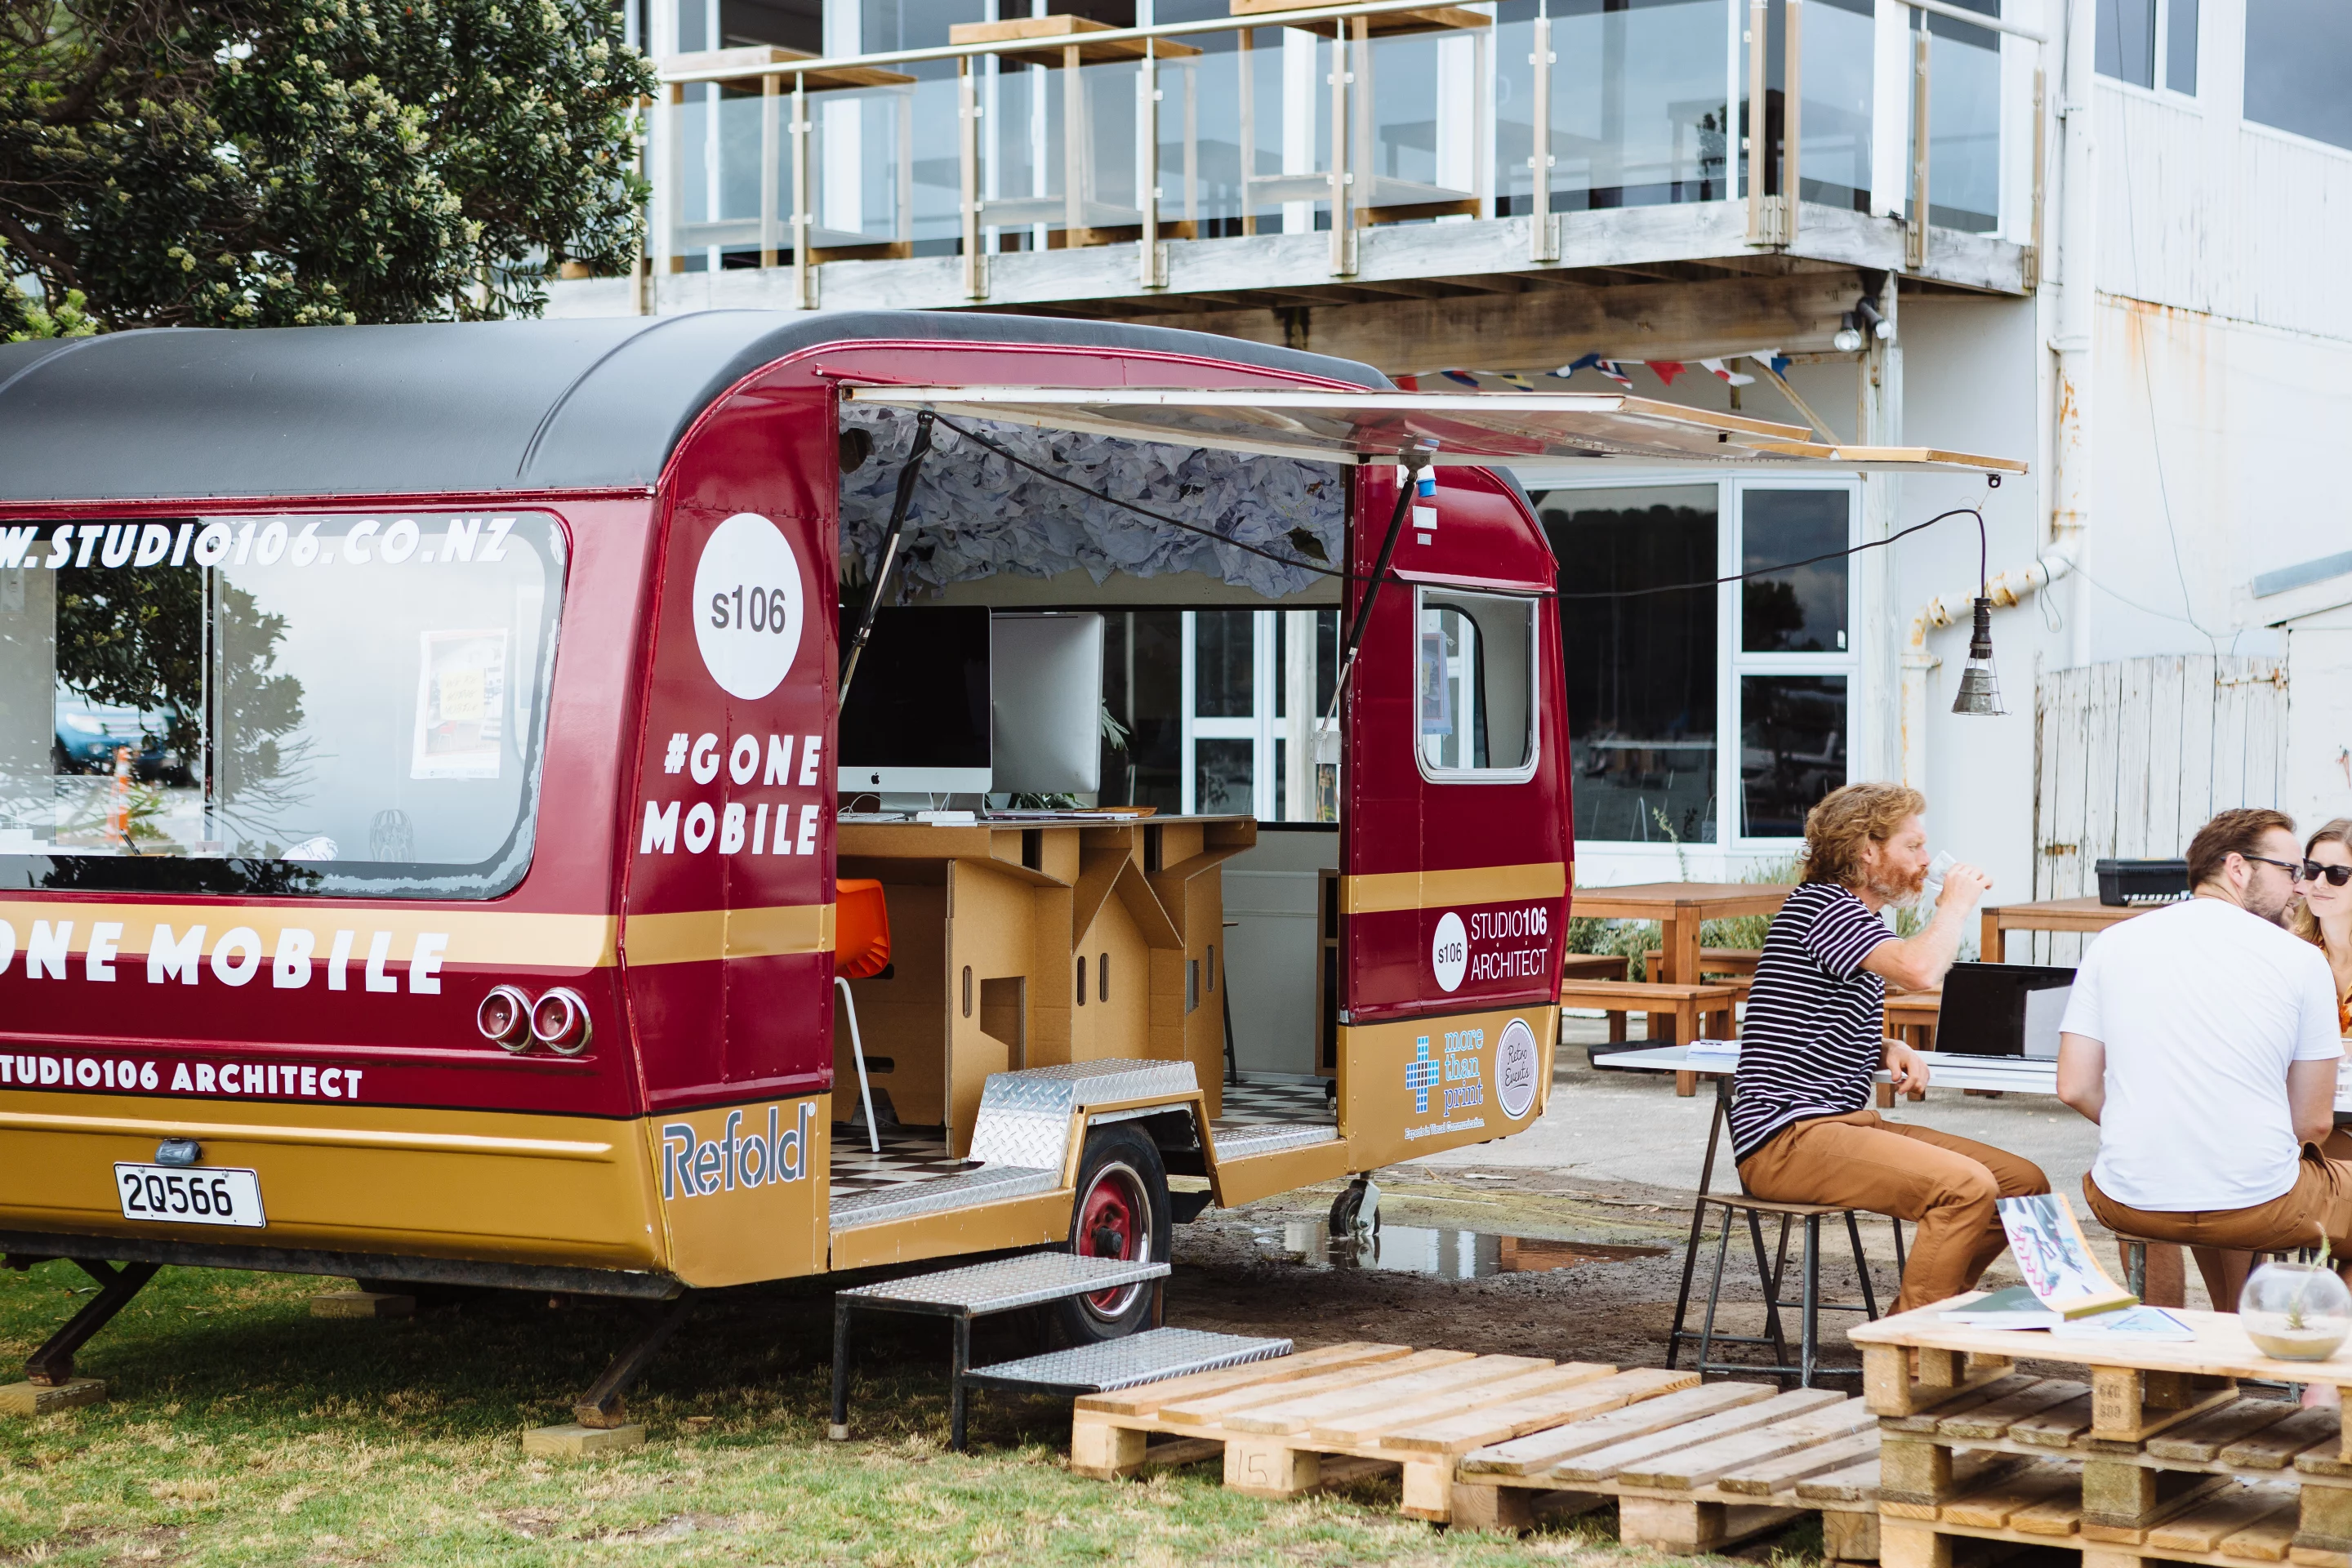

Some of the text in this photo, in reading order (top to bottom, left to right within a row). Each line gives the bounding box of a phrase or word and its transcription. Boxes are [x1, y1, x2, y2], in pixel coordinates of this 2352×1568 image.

[710, 584, 786, 635] s106
[663, 732, 822, 786] #GONE
[639, 800, 819, 855] MOBILE
[1471, 906, 1548, 940] STUDIO106
[147, 924, 449, 996] MOBILE
[1438, 942, 1462, 964] s106
[1471, 948, 1548, 981] ARCHITECT
[1444, 1028, 1484, 1054] more
[1507, 1043, 1528, 1065] Retro
[171, 1062, 363, 1099] ARCHITECT
[1444, 1053, 1481, 1081] than
[1504, 1062, 1530, 1087] Events
[1443, 1077, 1484, 1117] print
[123, 1174, 234, 1217] 2Q566
